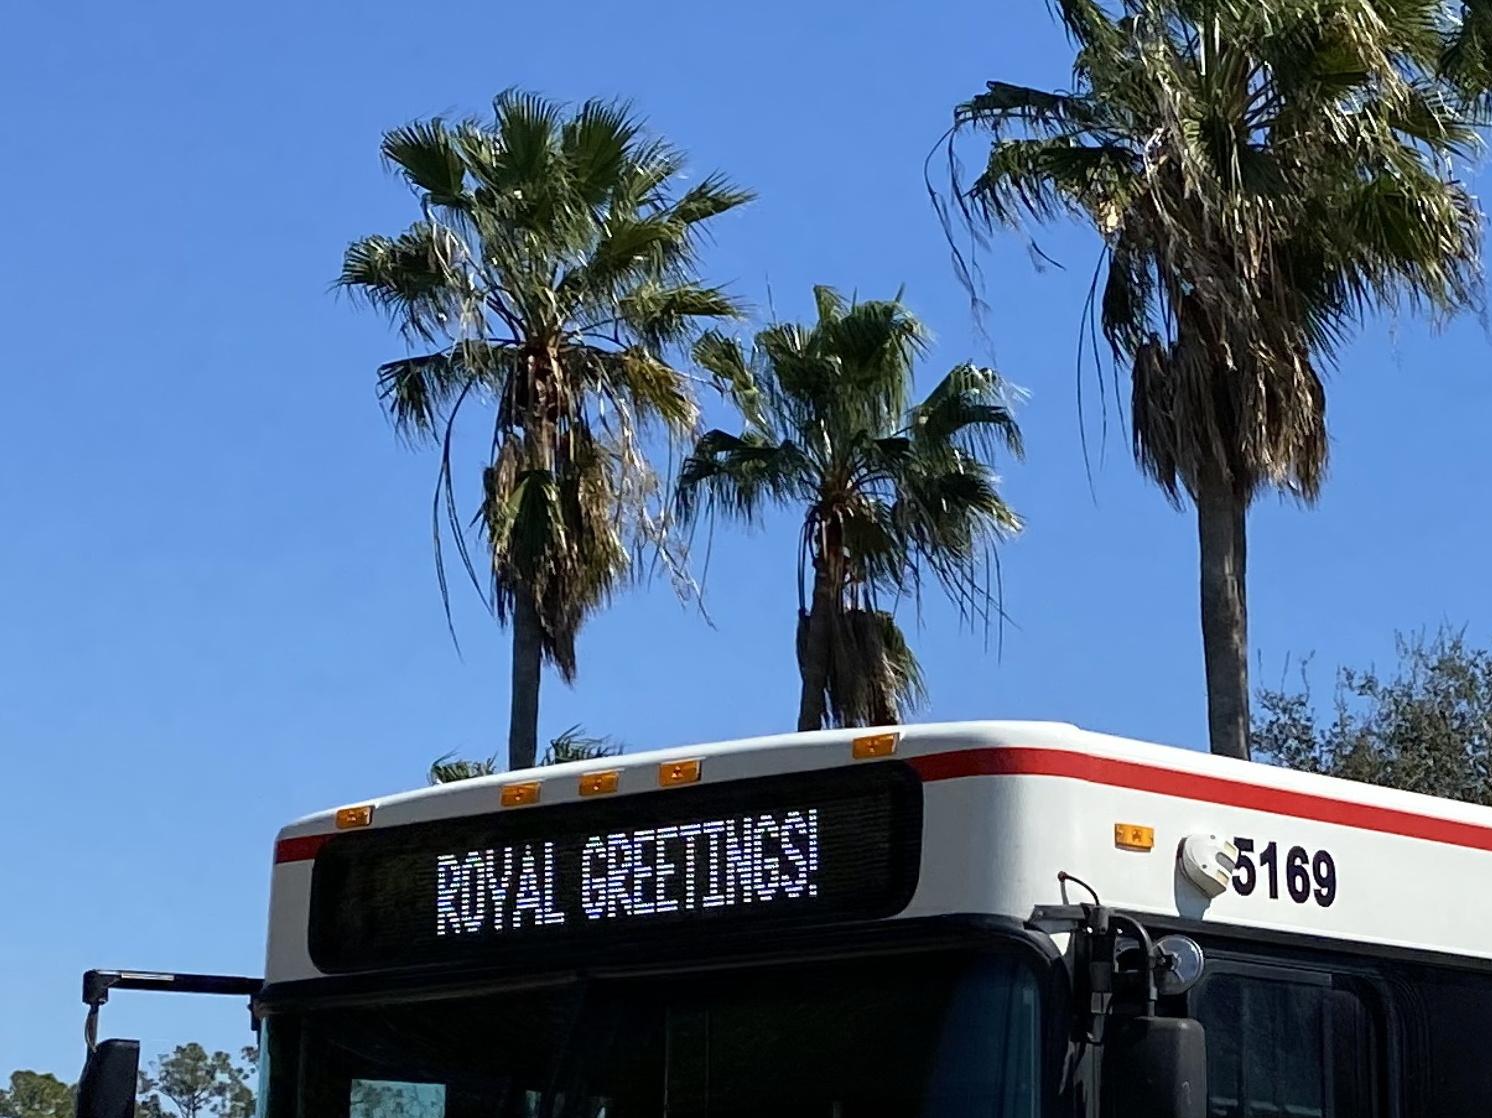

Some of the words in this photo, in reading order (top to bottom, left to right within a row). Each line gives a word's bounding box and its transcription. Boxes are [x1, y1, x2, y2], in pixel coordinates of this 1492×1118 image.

[436, 841, 565, 936] ROYAL
[581, 808, 818, 919] GREETINGS!
[1232, 836, 1337, 908] 5169
